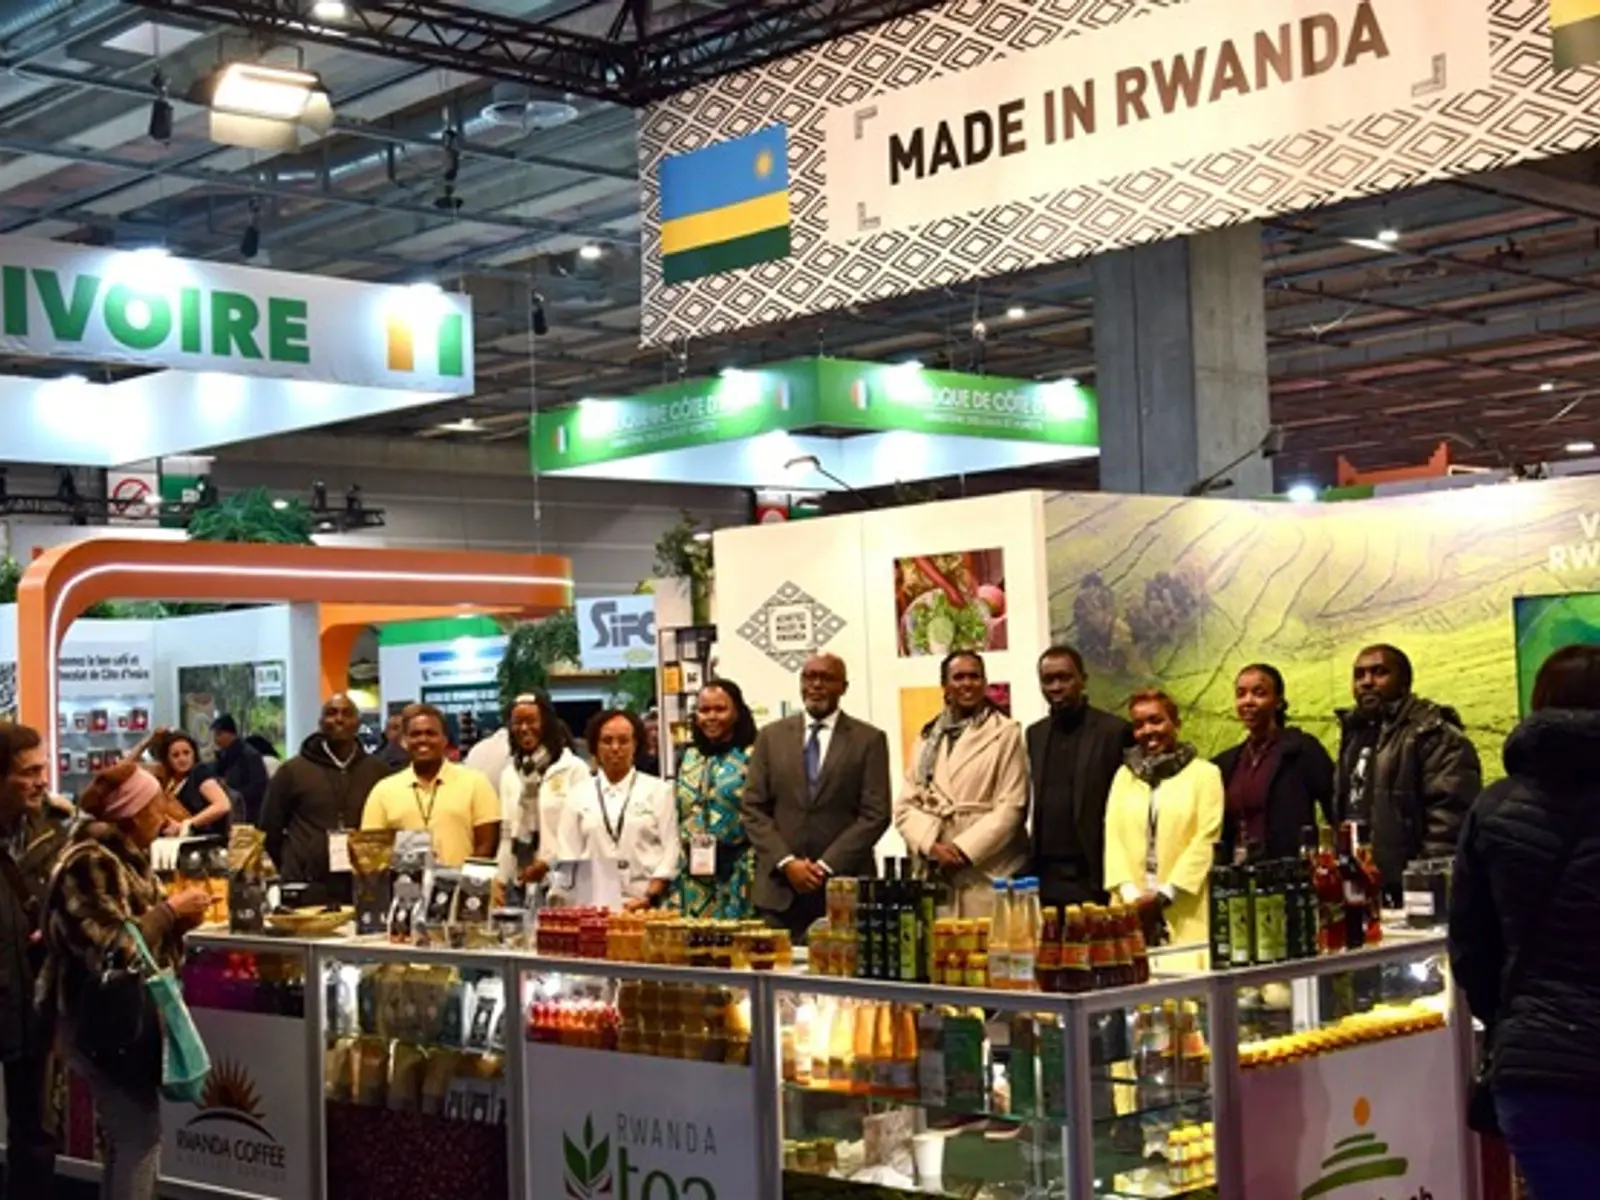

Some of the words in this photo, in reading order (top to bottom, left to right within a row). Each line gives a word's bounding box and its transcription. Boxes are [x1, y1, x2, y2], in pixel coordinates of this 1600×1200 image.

[888, 98, 1027, 186] MADE
[1043, 78, 1097, 145] IN
[1115, 0, 1390, 126] RWANDA
[1, 265, 310, 364] IVOIRE
[233, 1138, 286, 1169] COFFEE
[616, 1112, 718, 1156] RWANDA
